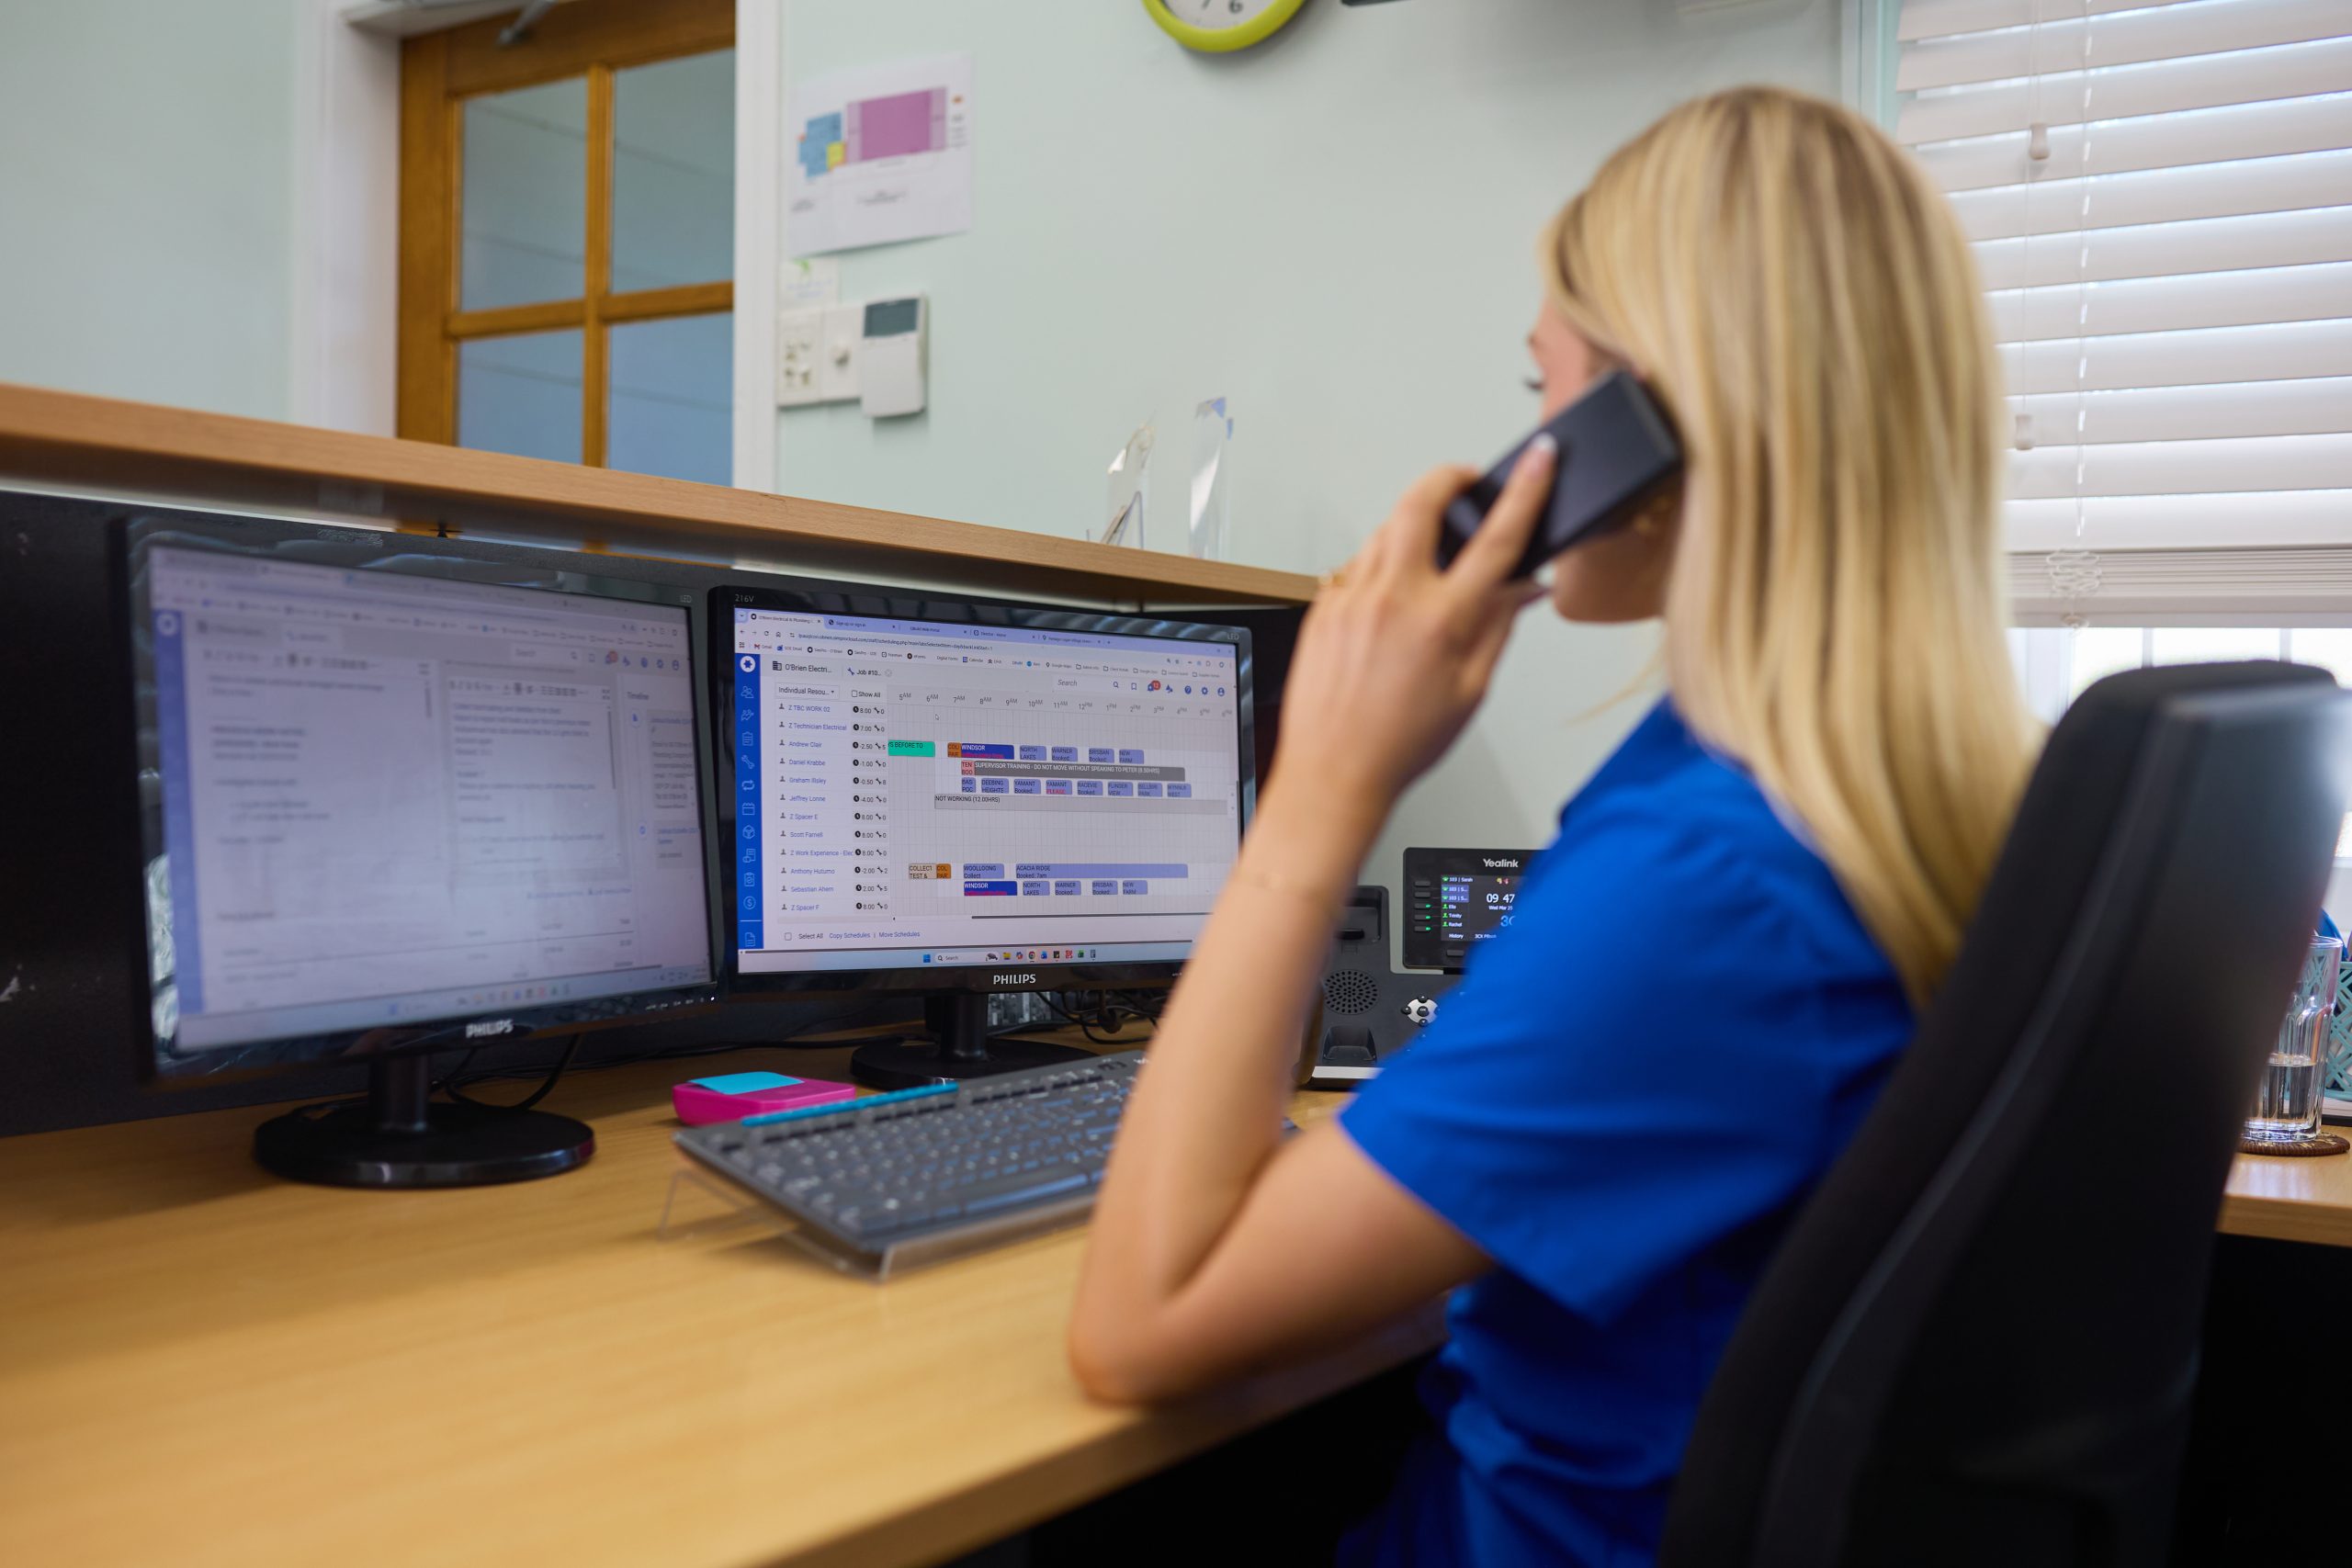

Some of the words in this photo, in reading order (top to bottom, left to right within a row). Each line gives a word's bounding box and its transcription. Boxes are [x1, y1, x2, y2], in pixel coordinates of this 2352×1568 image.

[1229, 0, 1243, 13] 6
[735, 594, 754, 603] 216V
[786, 663, 807, 671] O'Brien
[1057, 679, 1078, 687] Search
[778, 686, 807, 694] Individual
[899, 692, 911, 701] 5AM
[926, 694, 939, 703] 6AM
[953, 695, 966, 704] 7AM
[979, 696, 992, 705] 8AM
[1005, 698, 1018, 706] 9AM
[1028, 699, 1044, 707] 10AM
[1483, 858, 1519, 868] Yealink
[1486, 894, 1498, 903] 09
[1502, 894, 1515, 903] 47
[993, 974, 1036, 985] PHILIPS
[466, 1018, 514, 1038] PHILIPS
